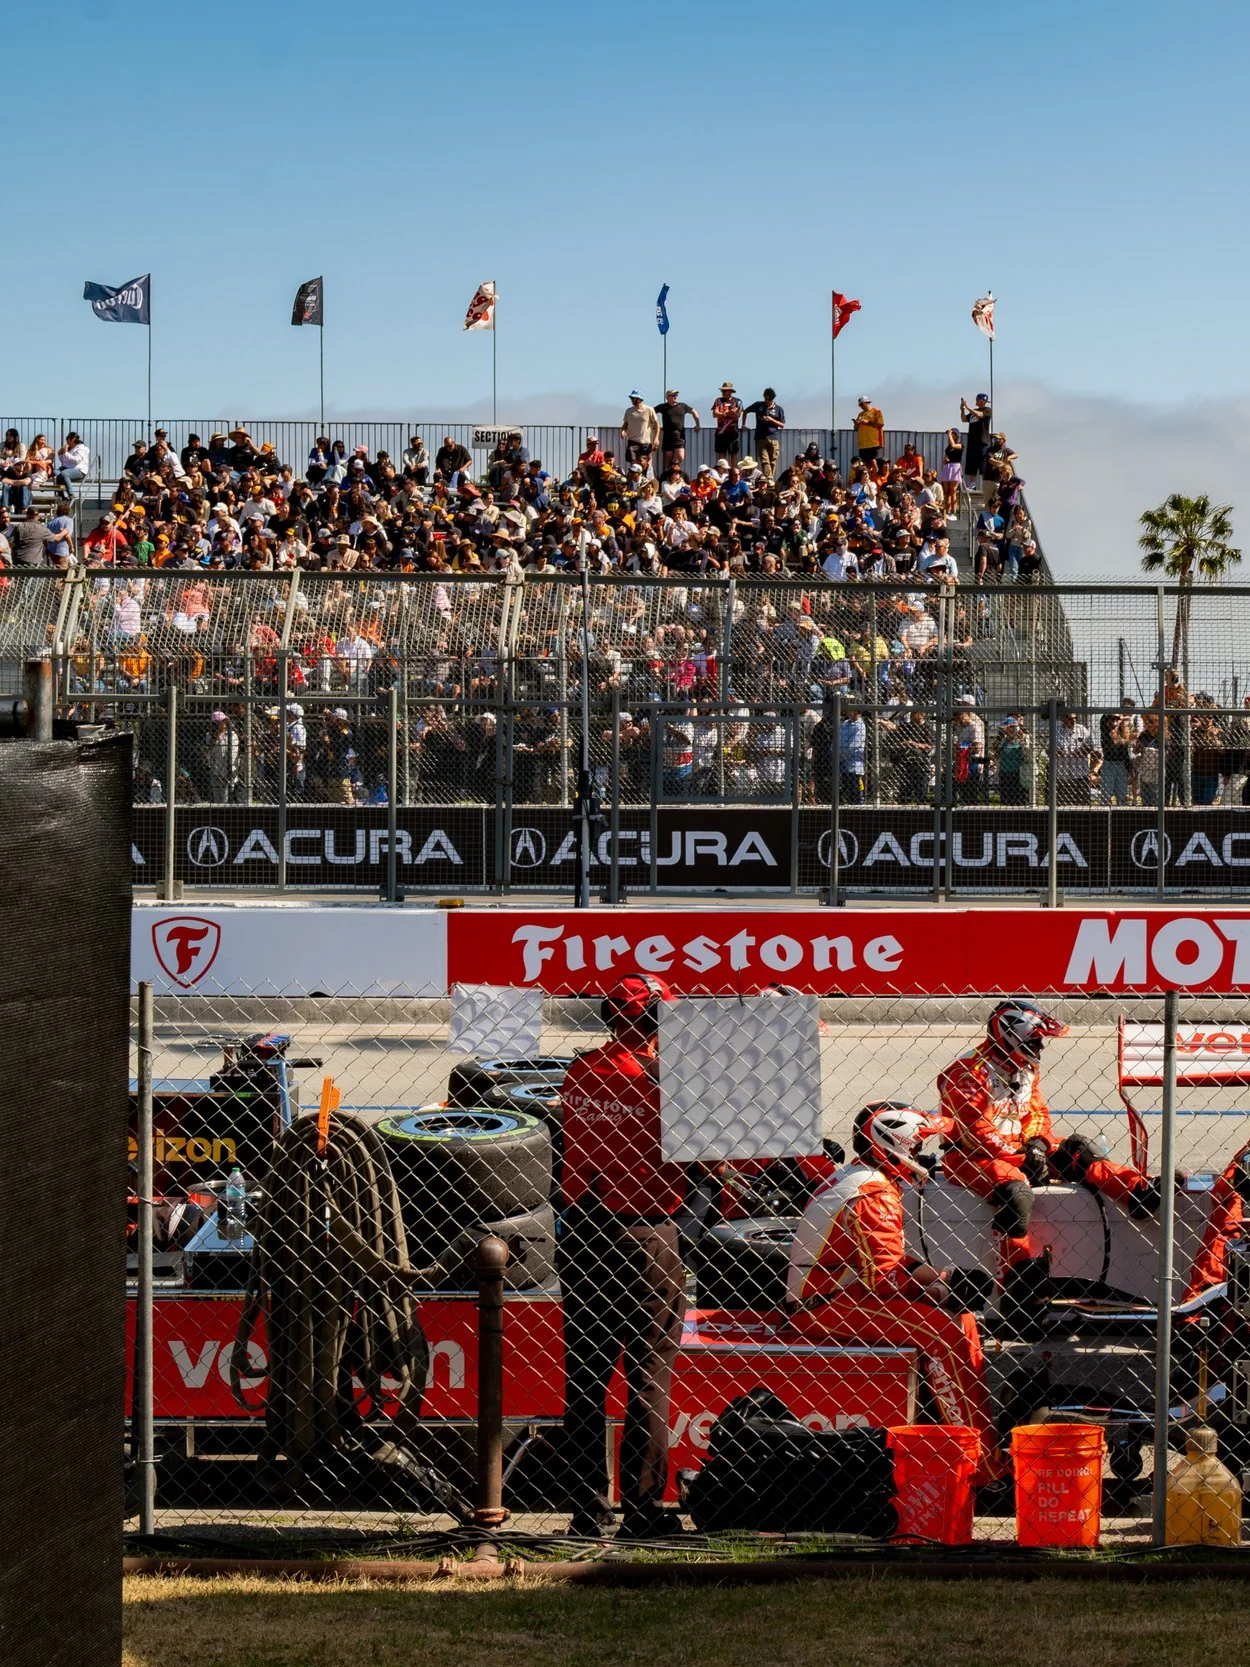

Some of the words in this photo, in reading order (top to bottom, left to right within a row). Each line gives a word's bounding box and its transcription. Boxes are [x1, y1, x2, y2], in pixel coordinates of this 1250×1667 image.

[474, 431, 513, 442] SECTIO
[232, 828, 465, 866] ACURA
[549, 830, 779, 867] ACURA
[862, 831, 1090, 868] ACURA
[511, 924, 904, 982] Firestone
[1038, 1481, 1069, 1494] FILL
[1038, 1496, 1059, 1508] DO
[1038, 1507, 1093, 1523] REPEAT
